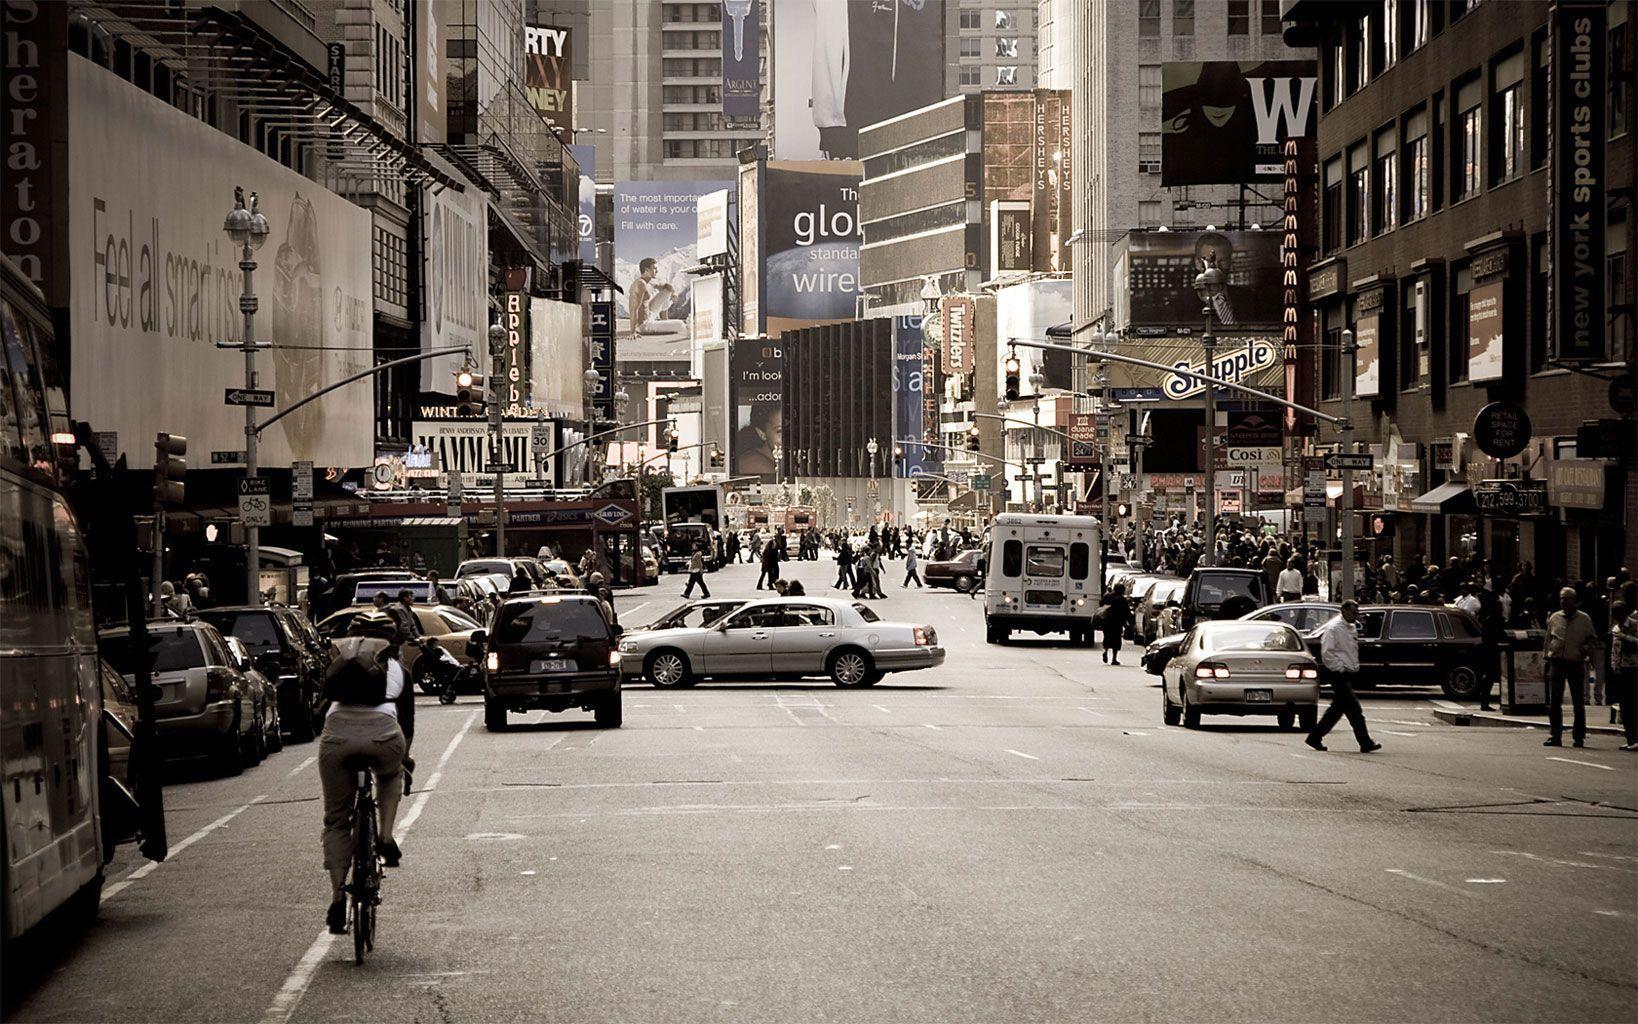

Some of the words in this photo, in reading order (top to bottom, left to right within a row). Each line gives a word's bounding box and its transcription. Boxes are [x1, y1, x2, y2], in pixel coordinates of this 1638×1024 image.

[525, 27, 567, 57] RTY
[1569, 17, 1591, 99] clubs
[1246, 77, 1316, 144] W
[6, 0, 43, 281] Sheraton
[1569, 104, 1597, 204] sports
[620, 194, 637, 202] The
[622, 221, 634, 230] Fill
[636, 222, 654, 230] with
[1569, 211, 1595, 279] york
[94, 198, 134, 328] Feel
[140, 217, 160, 333] all
[165, 239, 213, 342] smart
[1574, 285, 1591, 348] new
[950, 304, 964, 368] Twizzlers
[897, 353, 914, 361] Morgan
[743, 371, 760, 381] I'm
[254, 394, 268, 402] WAY
[1491, 411, 1519, 420] RETAIL
[1071, 425, 1095, 433] duane
[1491, 421, 1519, 430] SPACE
[440, 428, 456, 436] BENNY
[457, 428, 485, 436] ANDERSSON
[1496, 430, 1514, 439] FOR
[534, 438, 548, 446] 30
[1493, 438, 1516, 447] RENT
[1351, 457, 1367, 467] WAY
[250, 480, 266, 488] BIKE
[511, 513, 542, 523] PARTNER
